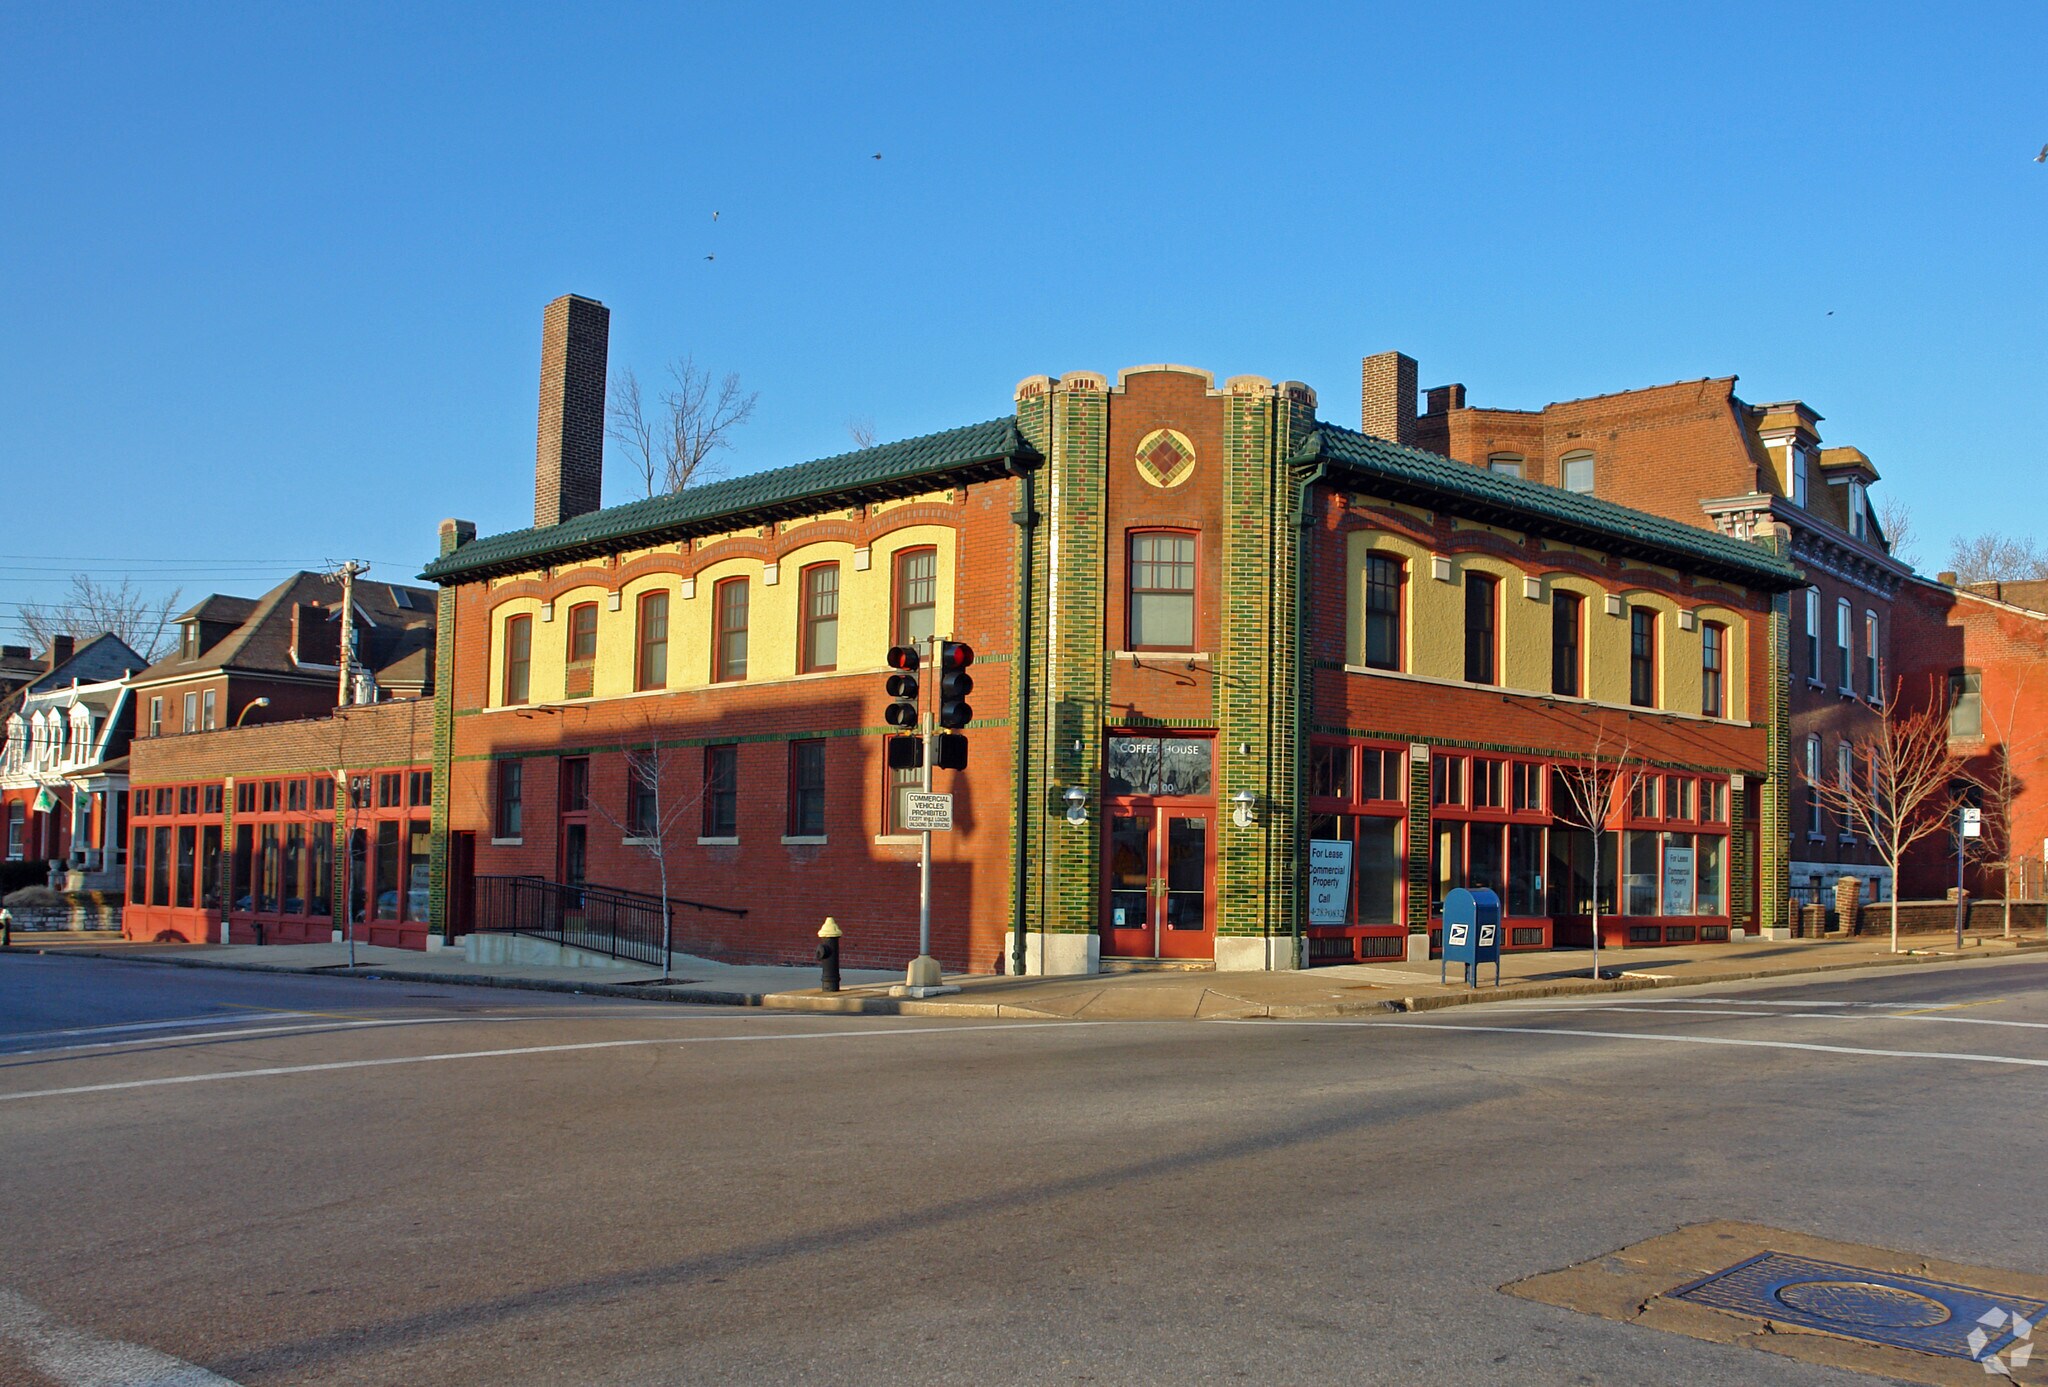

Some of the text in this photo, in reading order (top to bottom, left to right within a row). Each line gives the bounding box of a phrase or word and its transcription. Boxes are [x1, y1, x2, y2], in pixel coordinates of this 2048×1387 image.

[1120, 743, 1199, 755] COFFEE HOUSE
[1312, 847, 1344, 859] For Lease
[1309, 864, 1346, 875] Commercial
[1312, 876, 1340, 889] Property
[1318, 893, 1331, 904] Call
